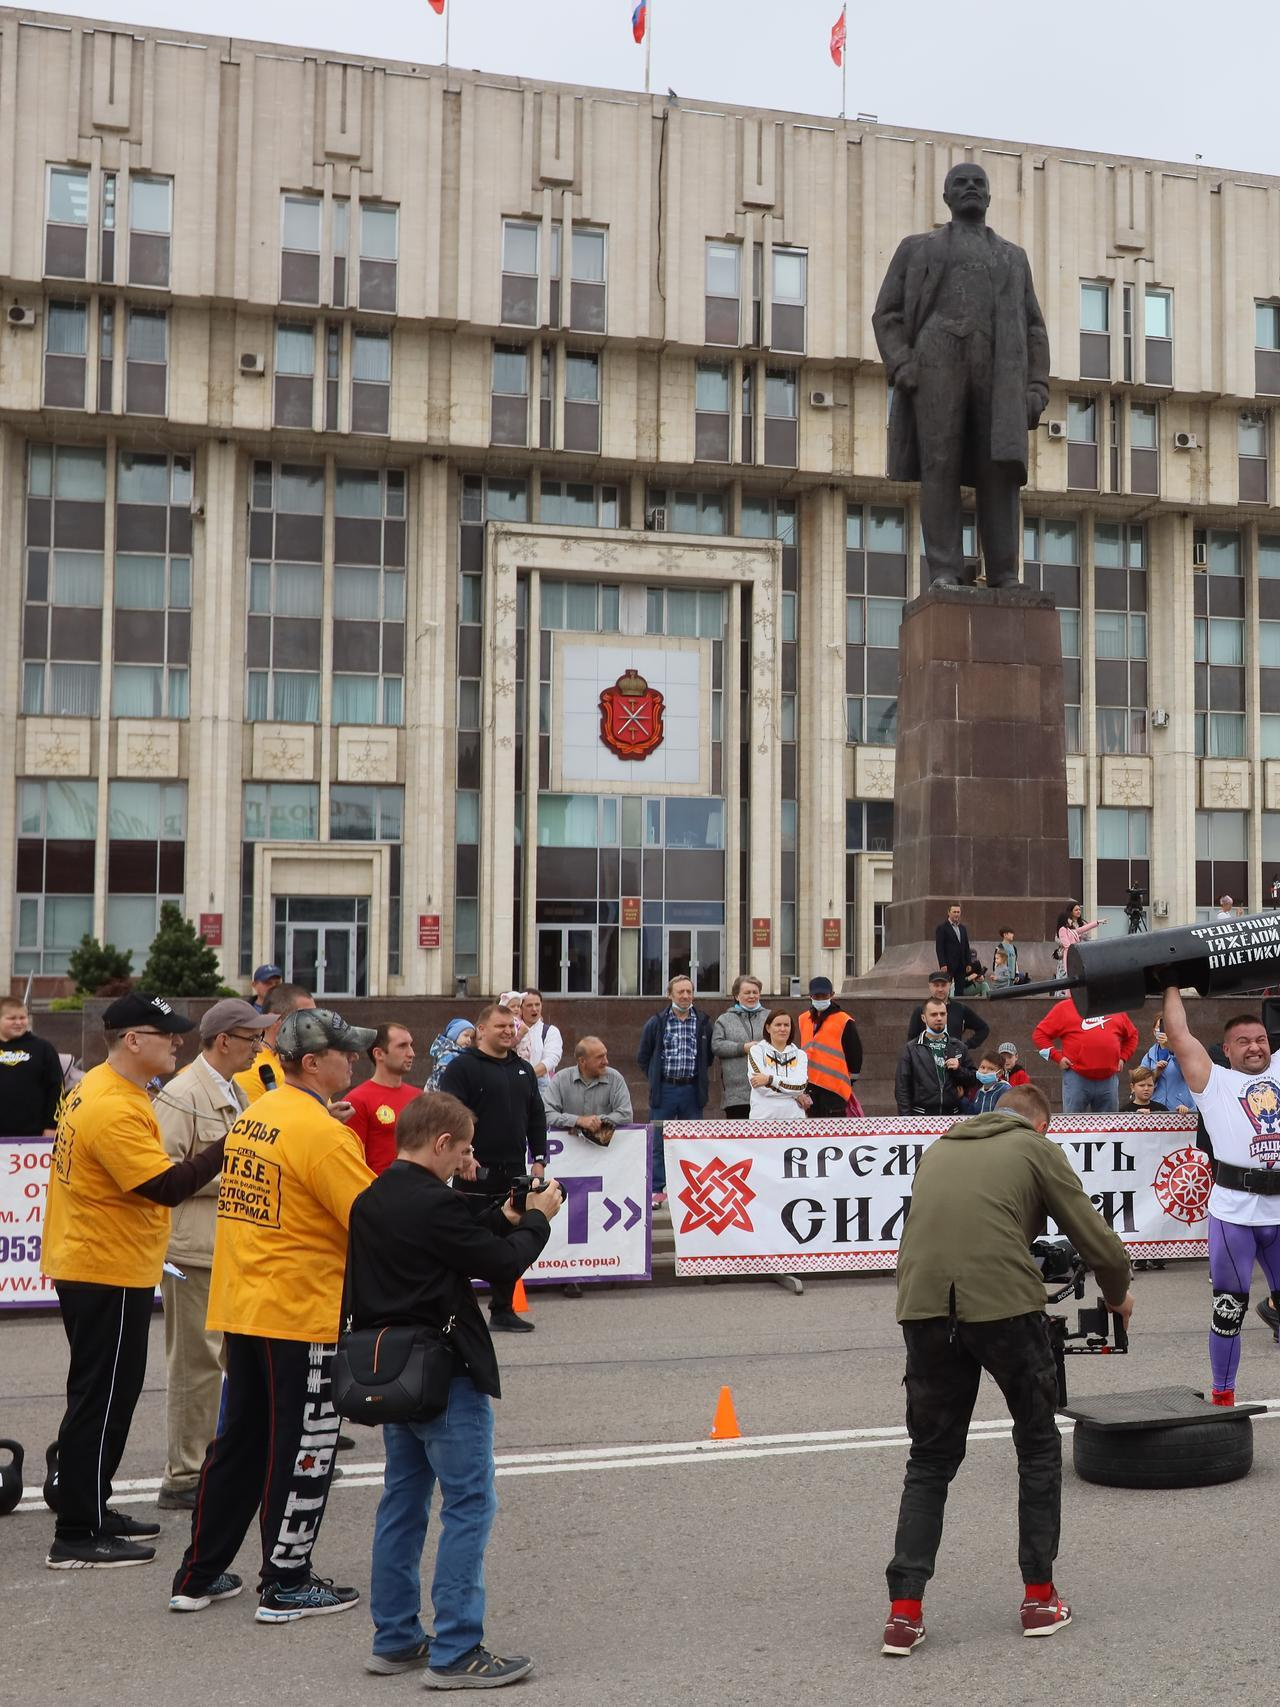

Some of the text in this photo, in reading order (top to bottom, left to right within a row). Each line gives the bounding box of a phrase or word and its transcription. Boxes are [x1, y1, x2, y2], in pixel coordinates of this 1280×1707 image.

[1206, 927, 1280, 952] ТЯЖЁЛОЙ
[232, 1119, 280, 1145] СУДЬЯ
[781, 1144, 924, 1179] ВРЕМ
[579, 1255, 620, 1267] торца)
[1057, 1284, 1075, 1300] RONIN
[270, 1401, 341, 1568] GET BIG
